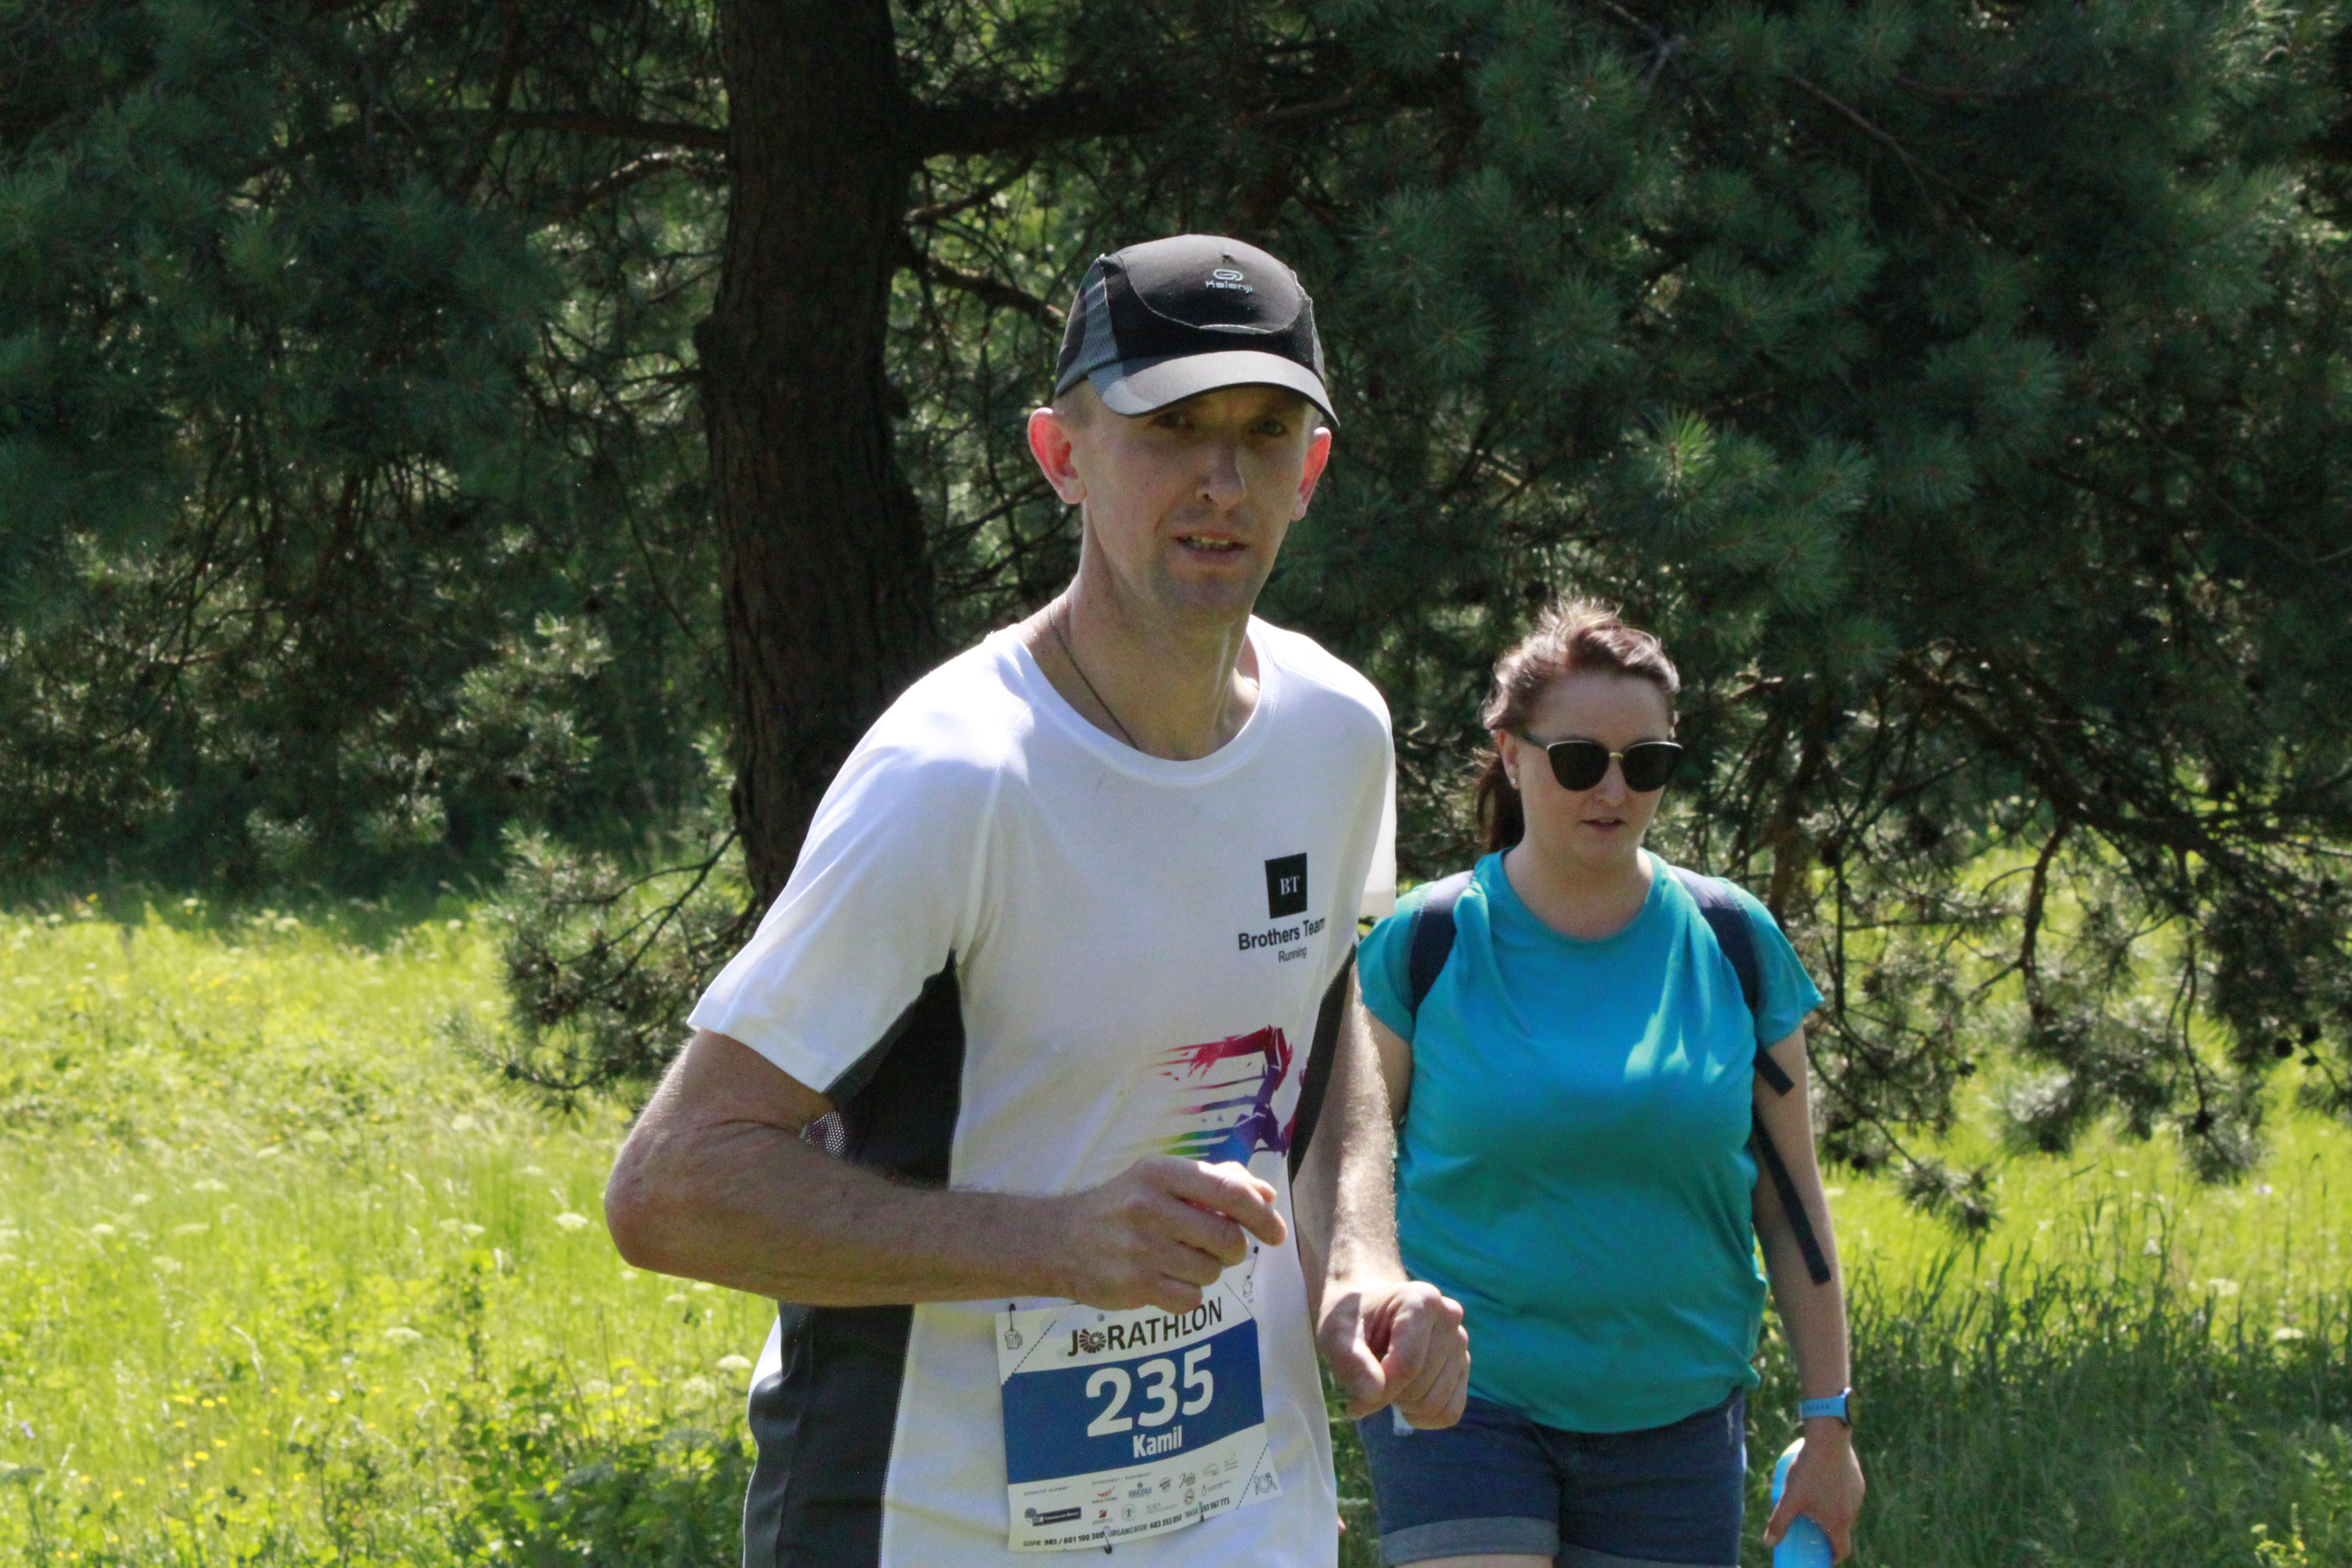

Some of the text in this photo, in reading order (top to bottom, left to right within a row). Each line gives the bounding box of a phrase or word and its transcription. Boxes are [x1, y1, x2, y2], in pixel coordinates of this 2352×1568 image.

[1205, 280, 1253, 294] Kalenji
[1279, 876, 1300, 895] BT
[1238, 917, 1326, 950] Brothers Team
[1278, 946, 1307, 962] Running
[1085, 1343, 1214, 1437] 235
[1132, 1424, 1182, 1458] Kamil
[1091, 1531, 1104, 1540] 300
[1150, 1520, 1161, 1529] 603
[1162, 1518, 1172, 1526] 353
